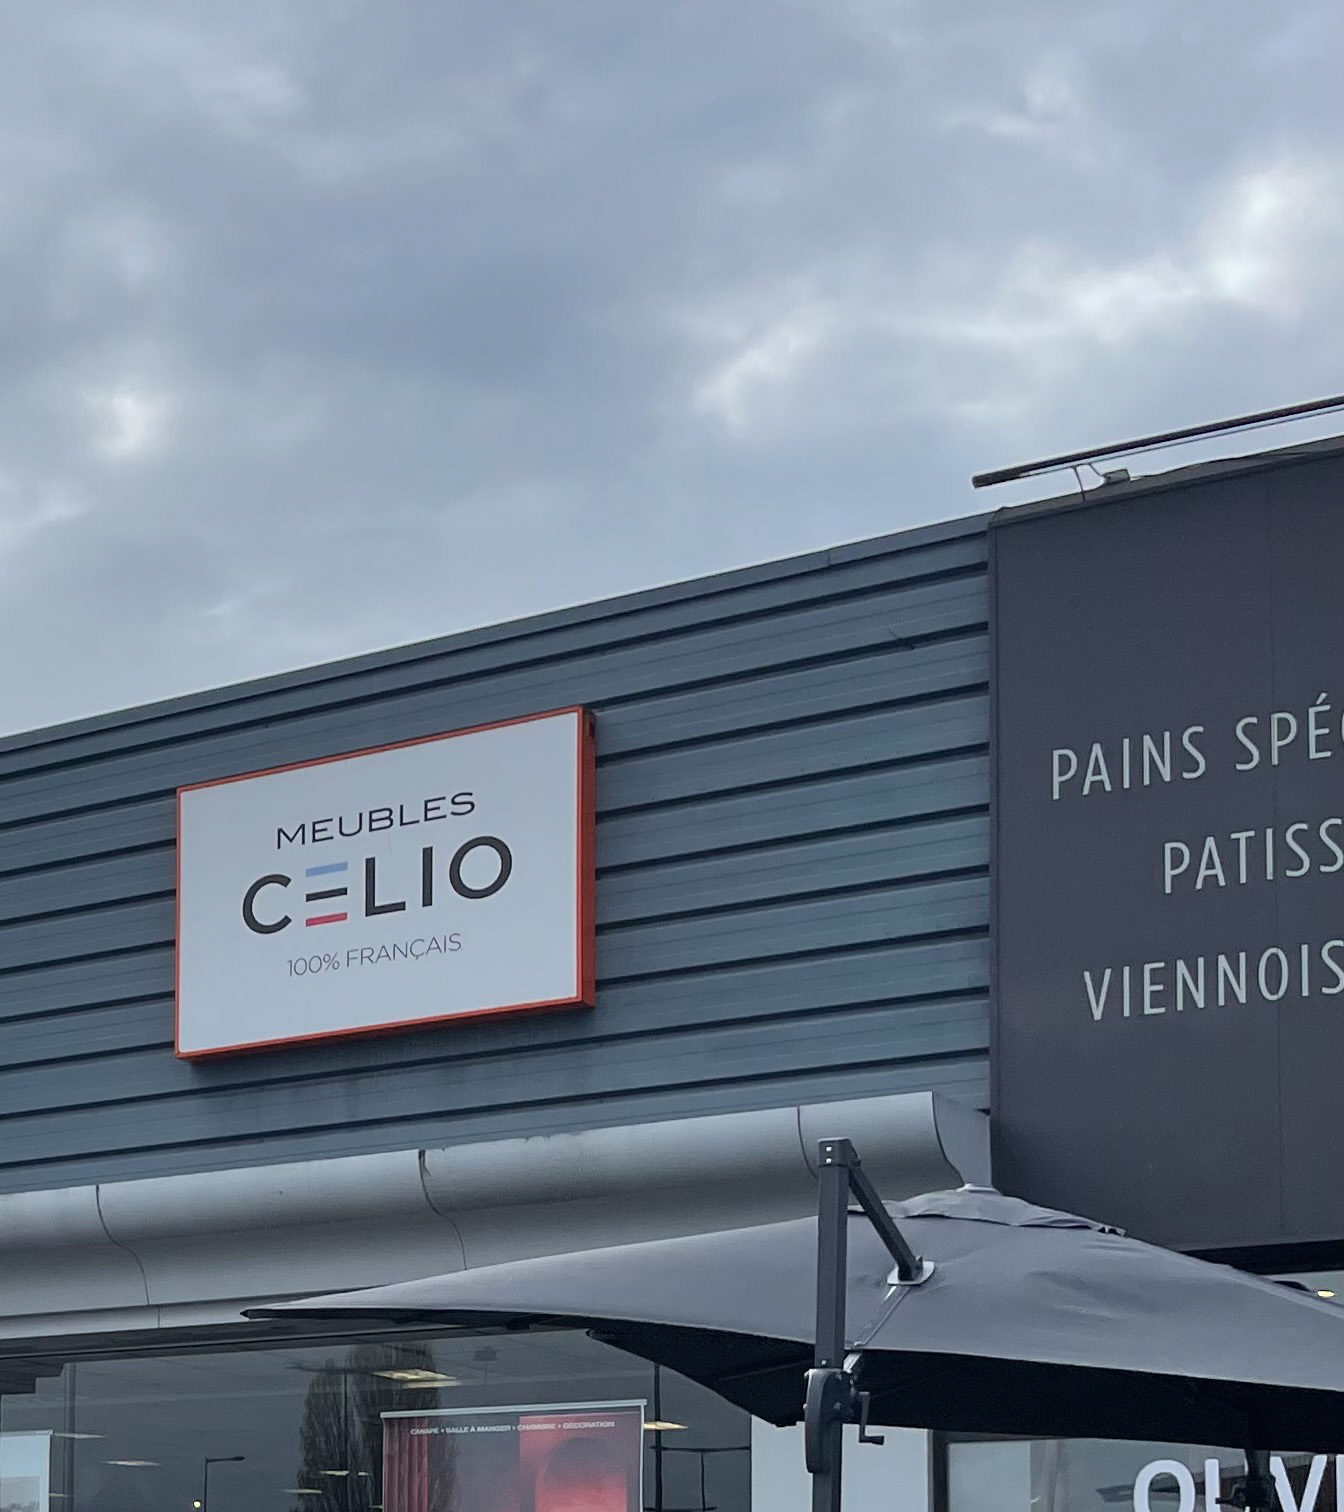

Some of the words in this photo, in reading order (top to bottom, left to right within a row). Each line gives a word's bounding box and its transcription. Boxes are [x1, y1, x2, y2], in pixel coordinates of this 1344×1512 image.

[1052, 725, 1206, 800] PAINS
[1235, 691, 1344, 772] SPÉ
[276, 791, 476, 850] MEUBLES
[1164, 817, 1344, 894] PATISS
[242, 835, 513, 935] CELIO
[286, 952, 340, 977] 100%
[346, 933, 463, 968] FRANÇAIS
[1083, 939, 1344, 1022] VIENNOIS
